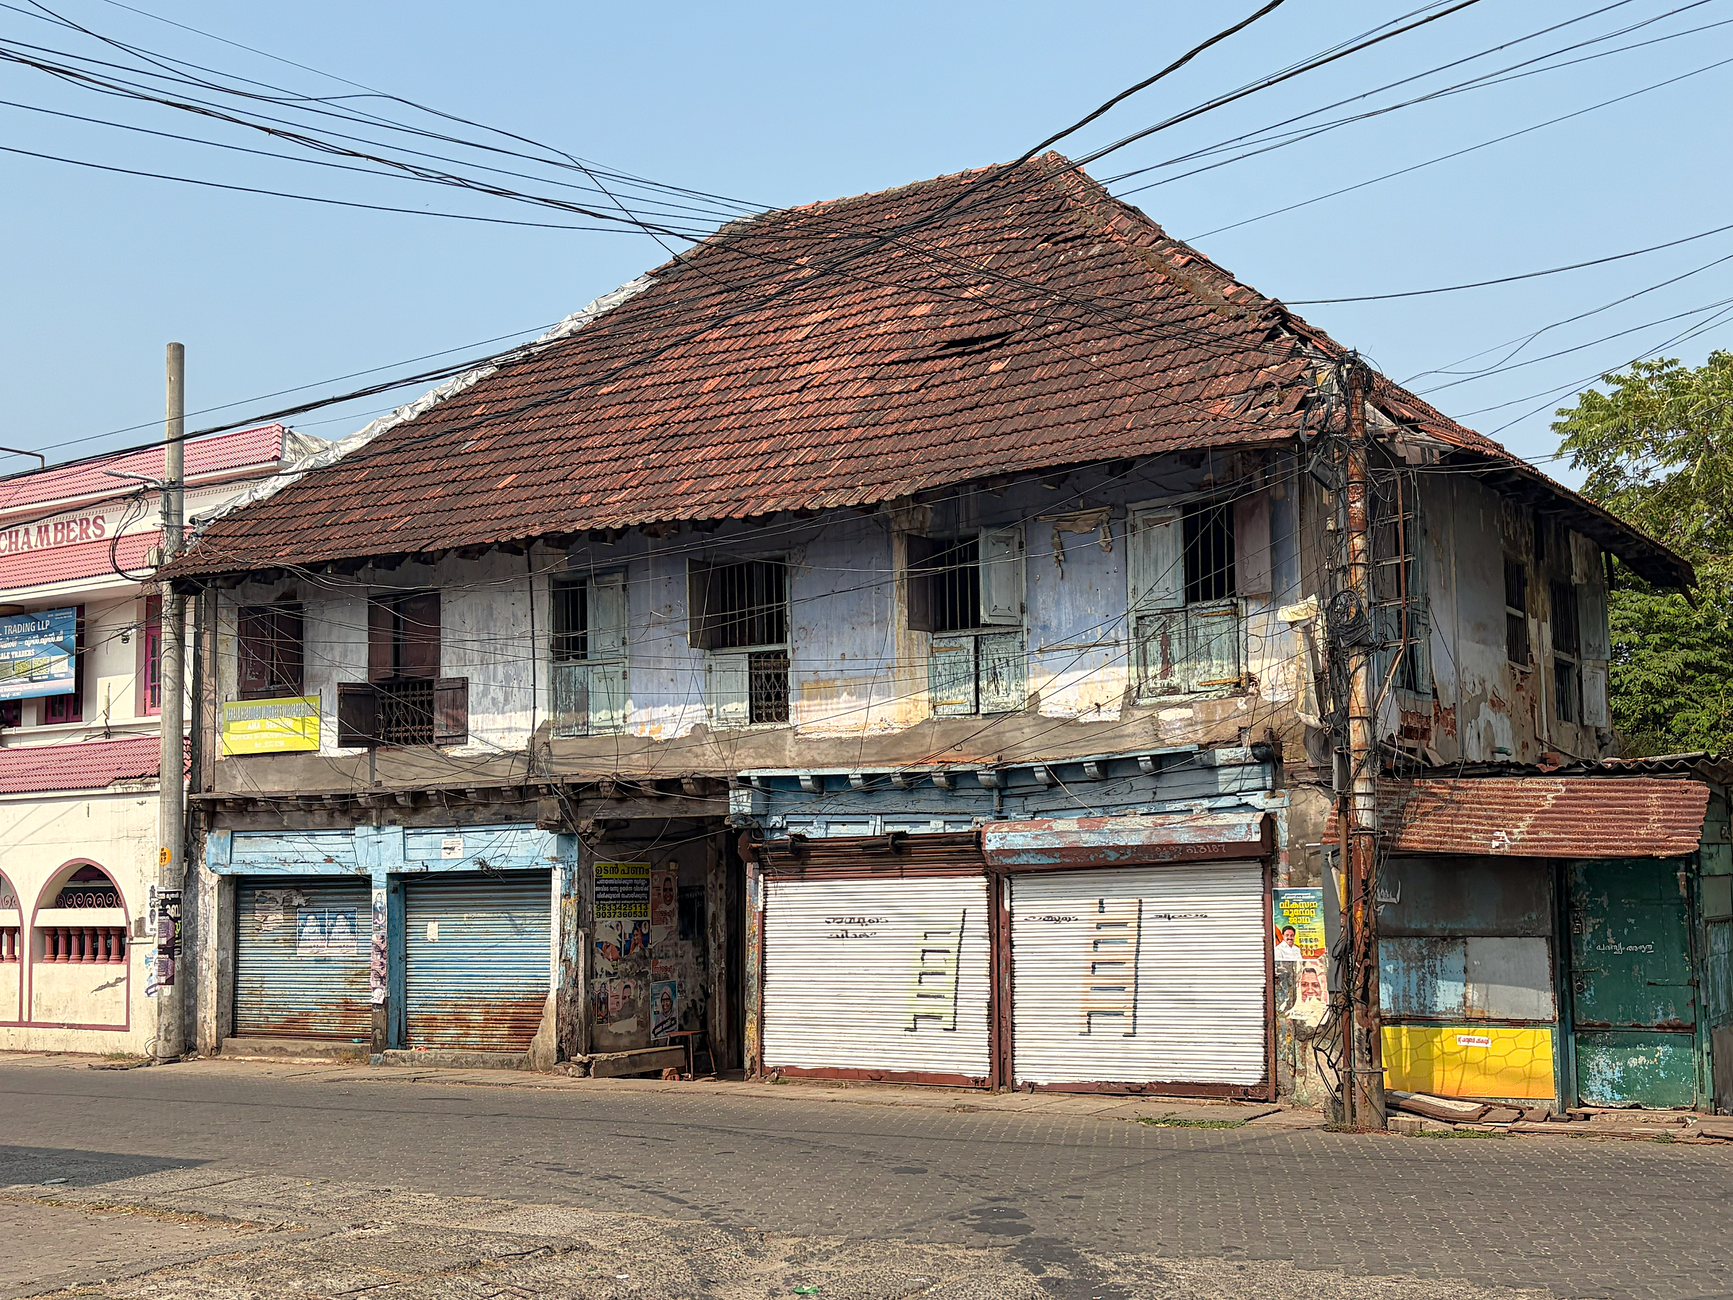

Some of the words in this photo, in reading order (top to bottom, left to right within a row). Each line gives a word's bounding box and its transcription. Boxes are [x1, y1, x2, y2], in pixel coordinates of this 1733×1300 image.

[0, 515, 106, 554] CHAMBERS
[4, 621, 36, 635] TRADING
[37, 620, 50, 631] LLP
[595, 863, 619, 877] ഉടൻ
[1279, 900, 1319, 909] വികസന
[595, 910, 648, 919] 9037360530
